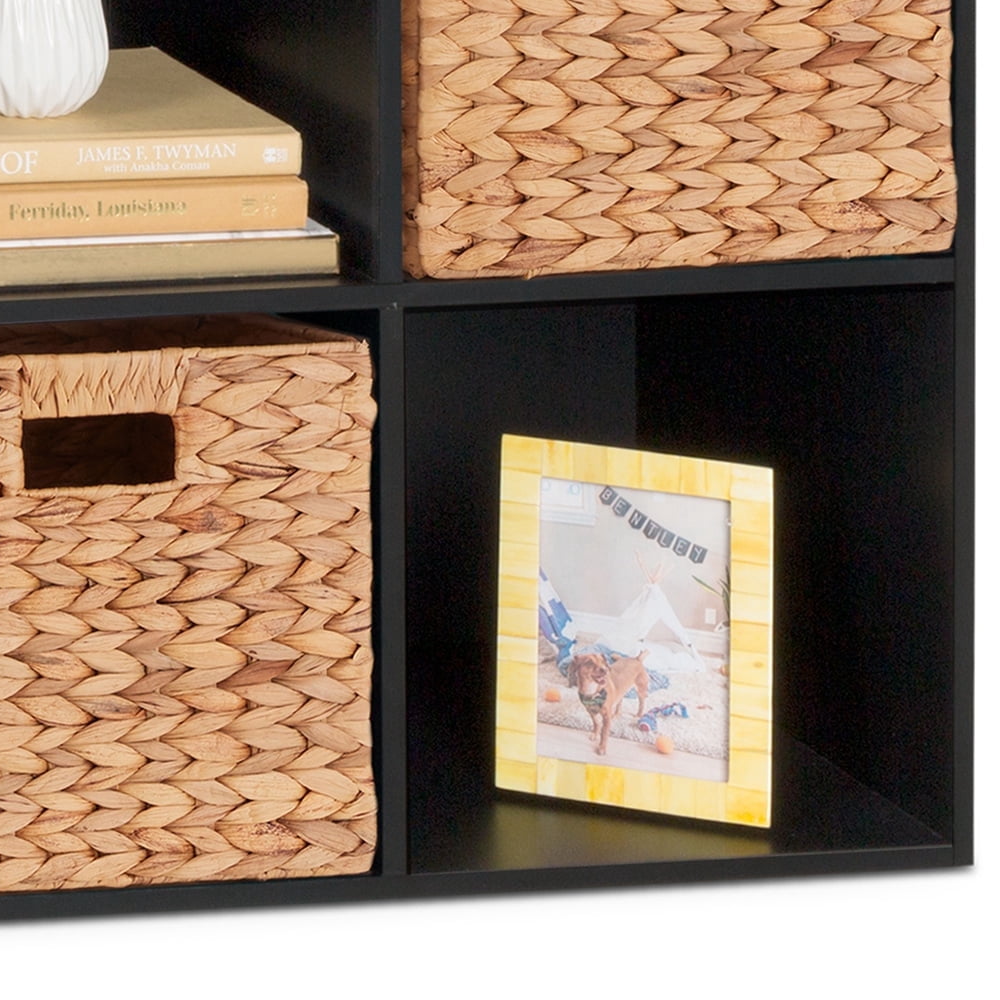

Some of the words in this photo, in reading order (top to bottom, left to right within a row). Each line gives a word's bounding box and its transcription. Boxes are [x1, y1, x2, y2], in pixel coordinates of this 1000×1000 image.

[76, 146, 131, 165] JAMES
[136, 145, 148, 160] F.
[153, 143, 237, 159] TWYMAN
[104, 162, 127, 173] with
[130, 160, 169, 172] Anakha
[172, 160, 211, 171] Coman
[8, 202, 91, 223] Ferriday,
[97, 199, 188, 218] Louisiana
[601, 488, 705, 562] BENTLEY
